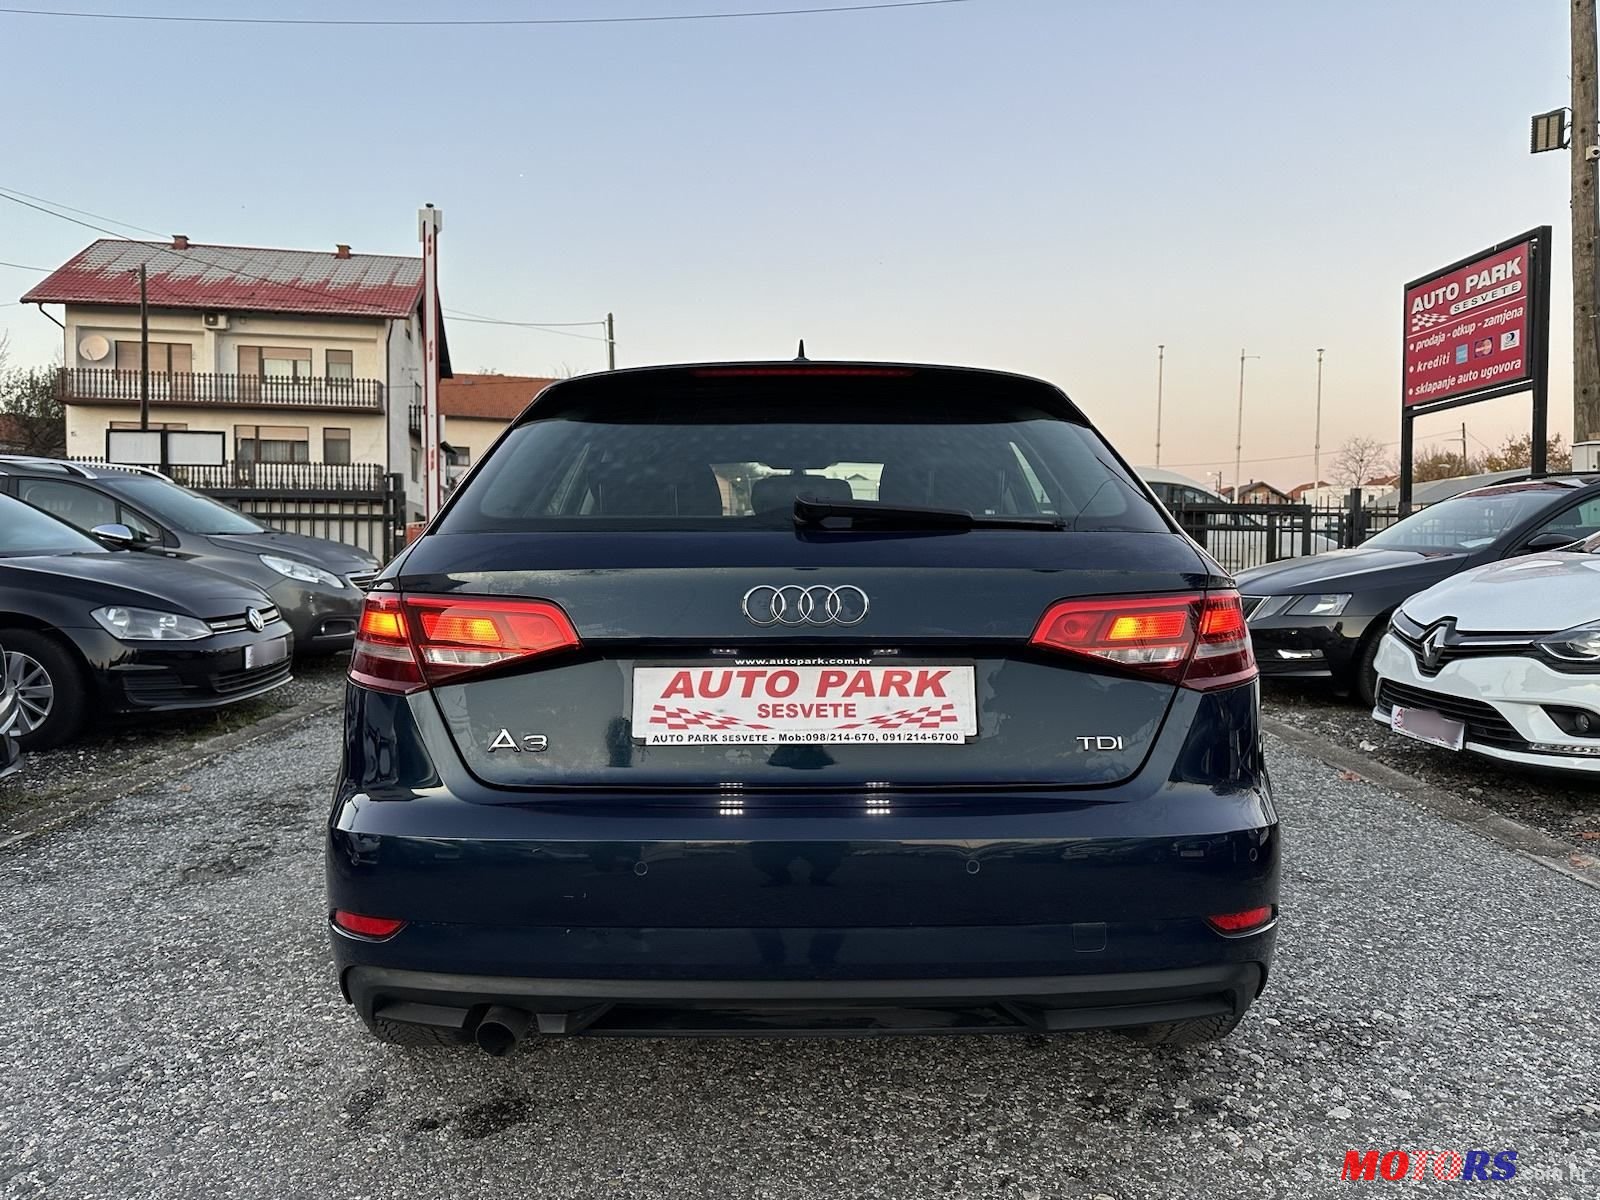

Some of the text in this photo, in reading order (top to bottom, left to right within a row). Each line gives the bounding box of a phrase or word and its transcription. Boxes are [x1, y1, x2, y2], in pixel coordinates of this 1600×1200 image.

[1411, 256, 1523, 315] AUTO PARK
[1453, 283, 1519, 312] SESVETE
[1415, 331, 1446, 352] prodaja
[1452, 322, 1476, 339] otkup
[1483, 306, 1523, 328] zamjena
[1416, 352, 1450, 373] krediti
[1415, 358, 1522, 396] sklapanje auto ugovora
[734, 657, 872, 667] www.autopark.com.hr
[660, 670, 951, 699] AUTO PARK
[757, 703, 857, 719] SESVETE
[488, 728, 549, 753] A3
[652, 734, 684, 743] AUTO
[687, 734, 719, 743] PARK
[721, 734, 768, 742] SESVETE
[882, 732, 959, 742] 091/214-6700
[1076, 735, 1124, 751] TDI
